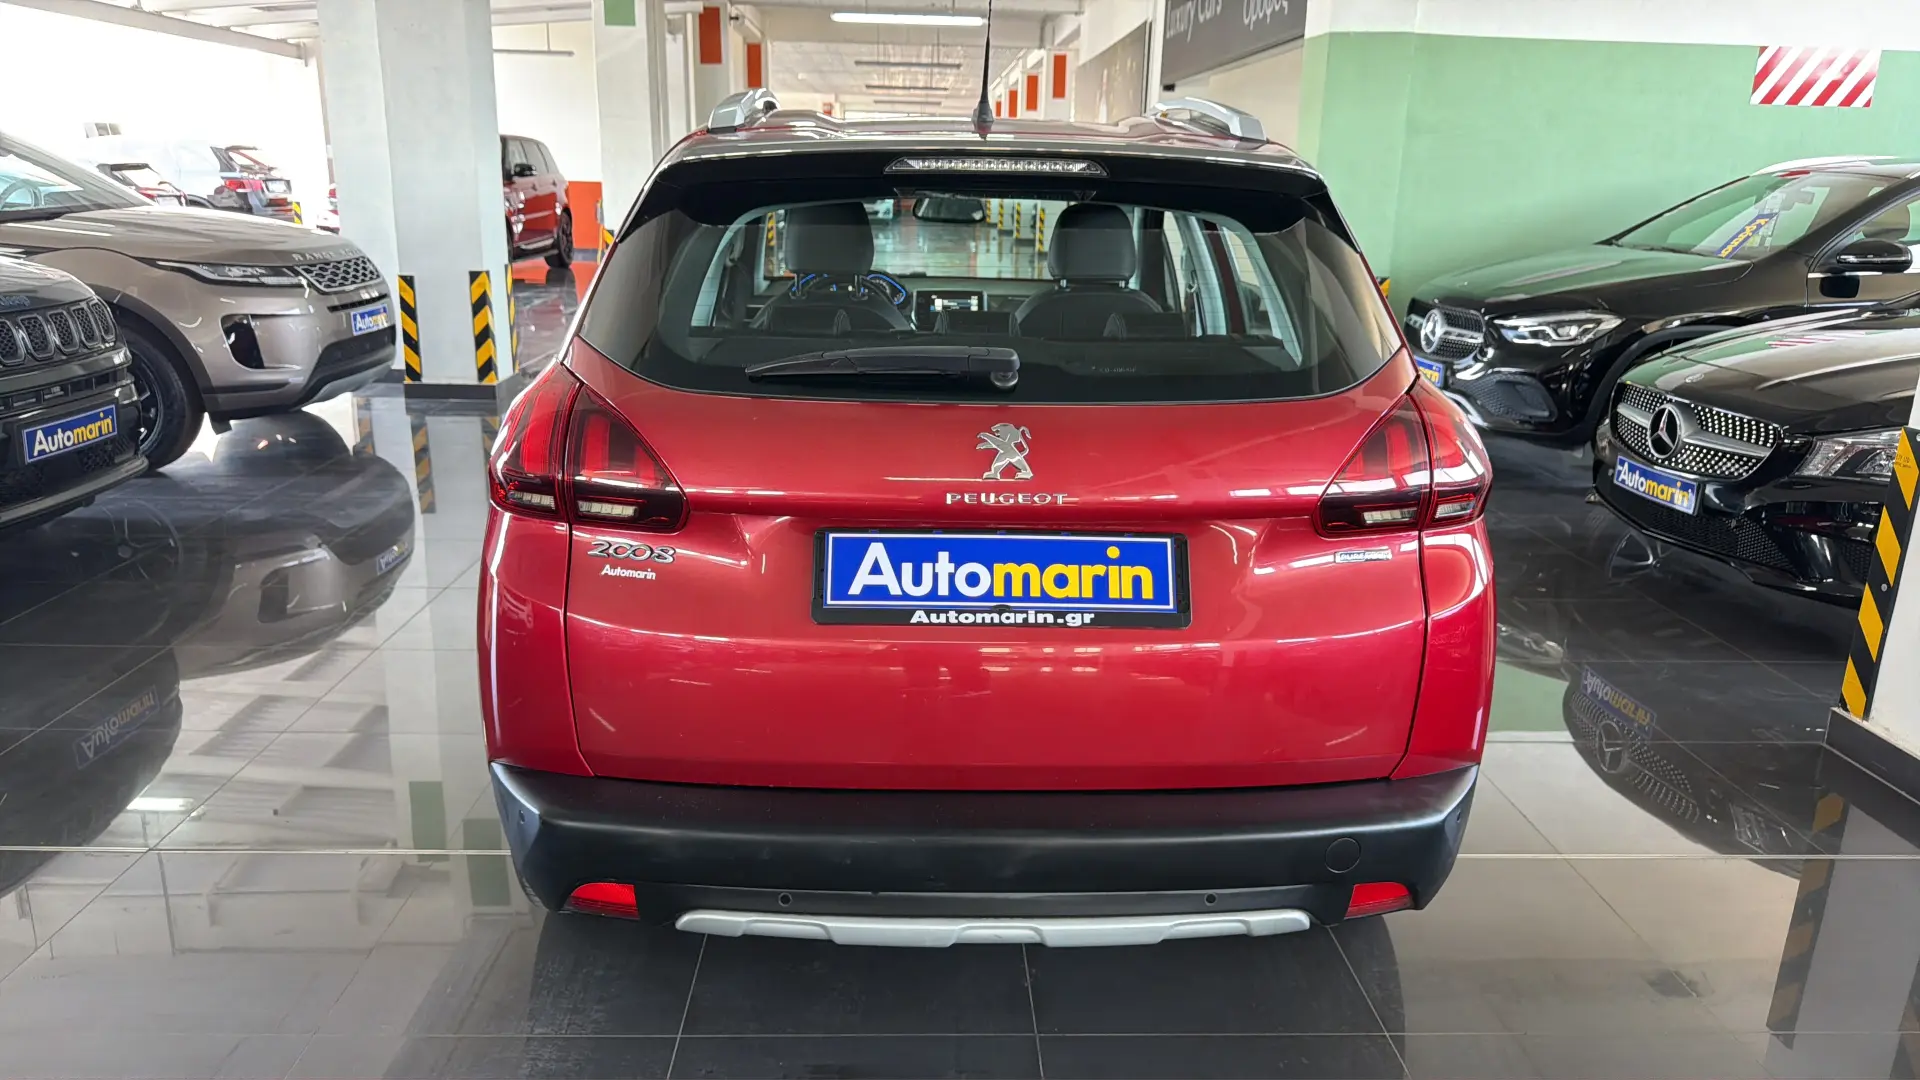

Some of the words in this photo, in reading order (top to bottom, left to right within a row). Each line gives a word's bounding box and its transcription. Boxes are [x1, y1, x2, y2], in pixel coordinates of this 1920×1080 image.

[33, 412, 112, 457] Automarin
[1618, 461, 1690, 507] Automarin
[946, 492, 1068, 505] PEUGEOT
[588, 540, 676, 563] 2008
[601, 564, 656, 580] Automarin
[848, 542, 1154, 599] Automarin
[910, 610, 1095, 627] Automarin.gr
